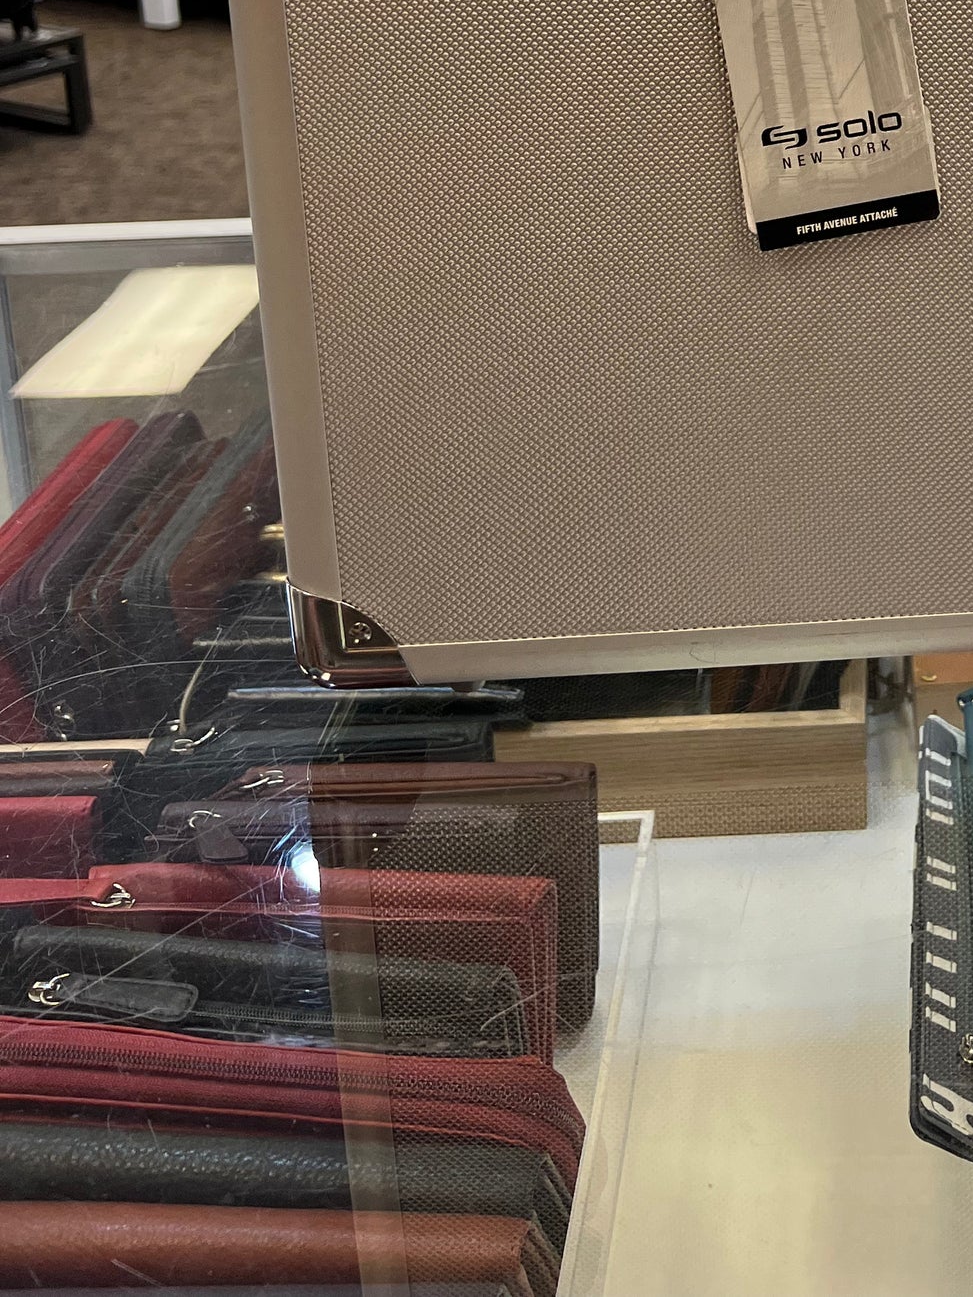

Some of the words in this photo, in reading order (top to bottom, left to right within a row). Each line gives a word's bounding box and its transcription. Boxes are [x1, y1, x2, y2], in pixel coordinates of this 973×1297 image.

[816, 110, 902, 144] solo
[782, 151, 823, 170] NEW
[838, 139, 891, 159] YORK
[796, 222, 822, 235] FIFTH
[823, 215, 858, 231] AVENUE
[859, 206, 898, 223] ATTACHÉ
